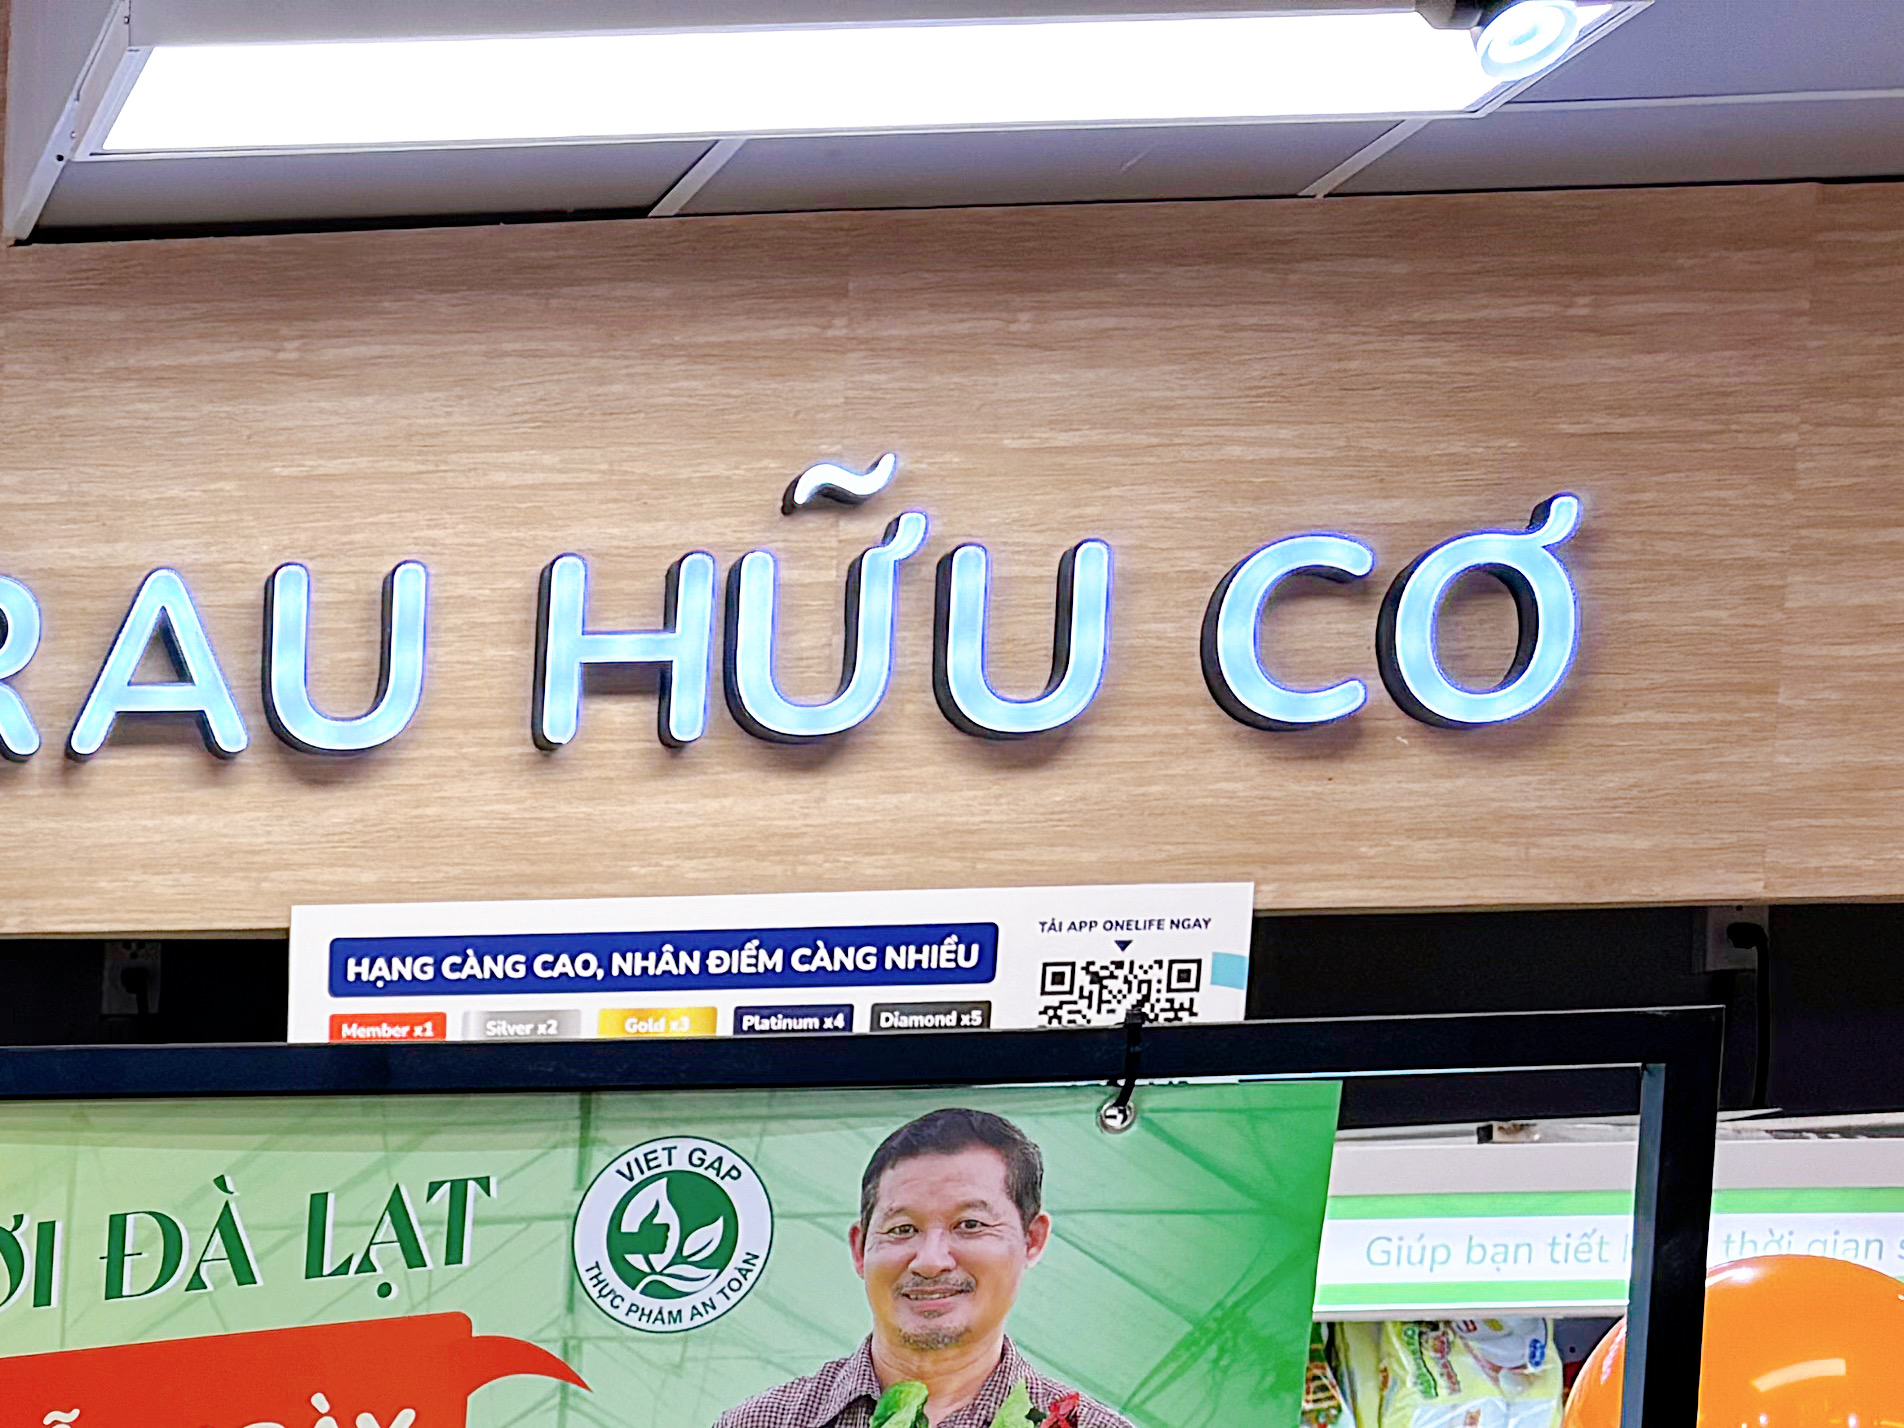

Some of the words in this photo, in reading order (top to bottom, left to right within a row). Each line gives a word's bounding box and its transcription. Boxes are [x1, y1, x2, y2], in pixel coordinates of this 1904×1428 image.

[533, 451, 1112, 751] HỮU
[1200, 490, 1584, 731] CƠ
[1067, 919, 1097, 933] APP
[1101, 918, 1165, 933] ONELIFE
[1170, 917, 1212, 933] NGAY
[346, 954, 435, 986] HẠNG
[441, 944, 527, 982] CÀNG
[531, 951, 604, 983] CAO,
[610, 944, 700, 979] NHÂN
[705, 933, 785, 976] ĐIỂM
[790, 938, 878, 973] CÀNG
[883, 932, 980, 971] NHIỀU
[741, 1012, 817, 1034] Platinum
[821, 1014, 845, 1032] x4
[878, 1009, 960, 1029] Diamond
[963, 1010, 983, 1029] x5
[616, 1145, 679, 1184] VIET
[687, 1147, 743, 1184] GAP
[99, 1172, 259, 1303] ĐÀ
[304, 1175, 493, 1299] LẠT
[1366, 1233, 1453, 1272] Giúp
[1467, 1233, 1532, 1273] bạn
[1547, 1228, 1610, 1264] tiết
